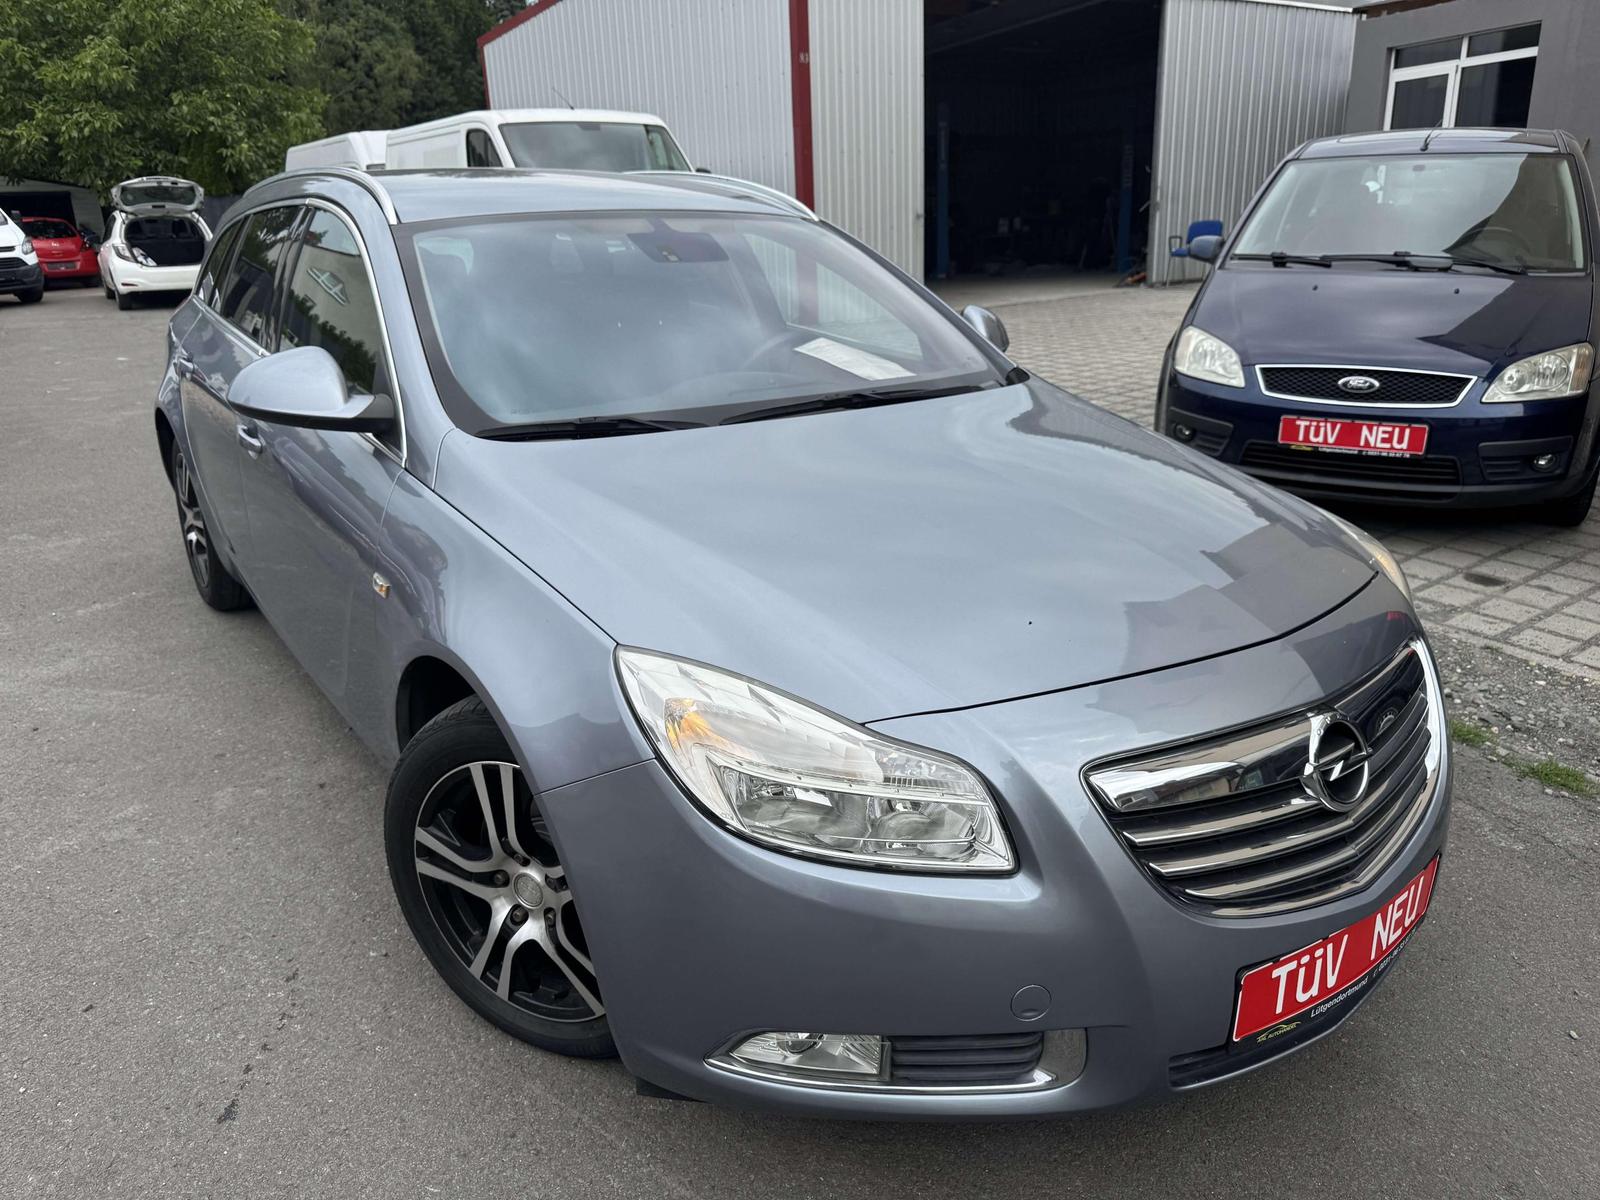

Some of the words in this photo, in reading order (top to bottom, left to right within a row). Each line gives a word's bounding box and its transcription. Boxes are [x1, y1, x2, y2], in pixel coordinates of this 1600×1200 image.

[1295, 419, 1341, 444] TÜV
[1359, 425, 1411, 449] NEU
[1271, 934, 1349, 1014] TÜV
[1371, 876, 1425, 961] NEU
[1310, 976, 1369, 1018] Lütgendortmund
